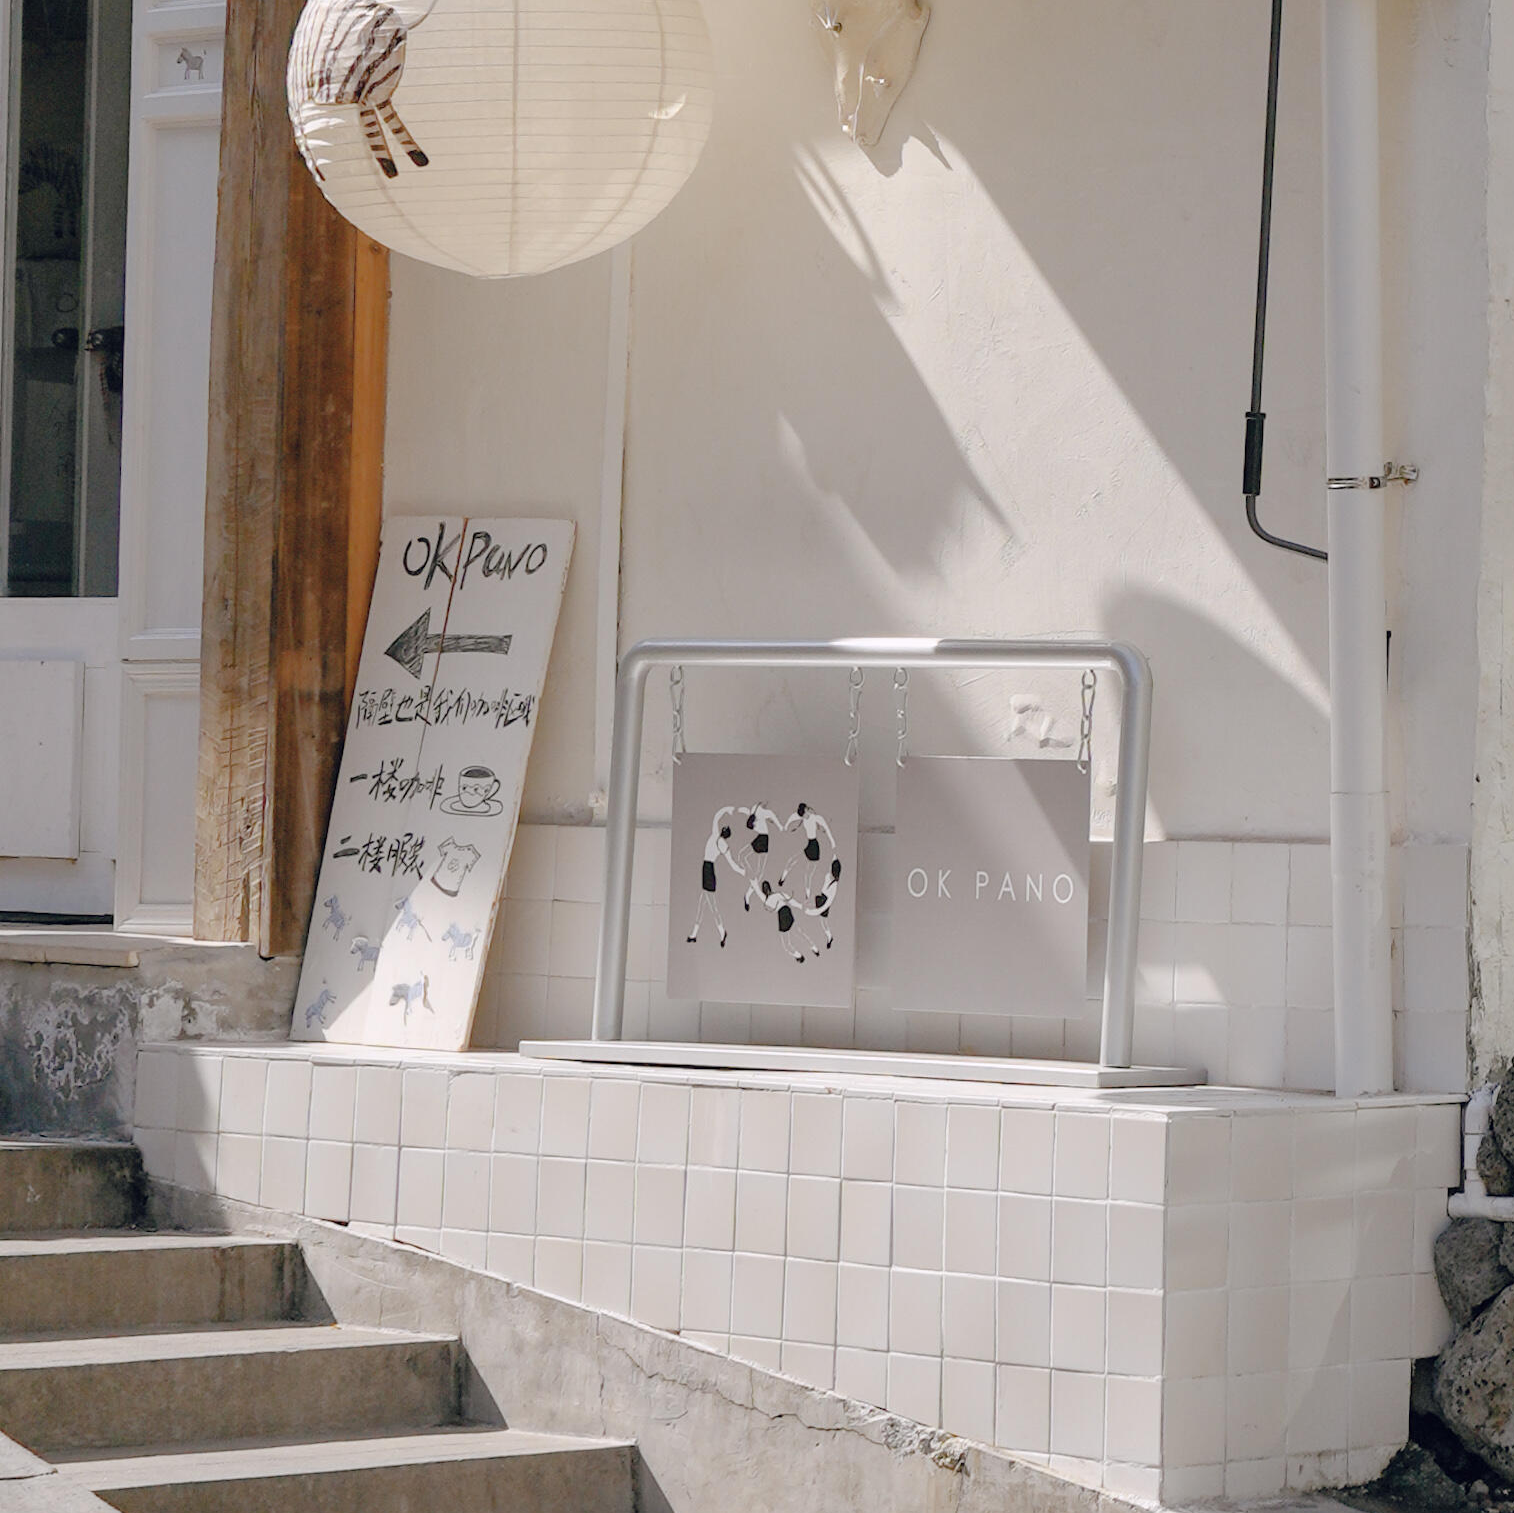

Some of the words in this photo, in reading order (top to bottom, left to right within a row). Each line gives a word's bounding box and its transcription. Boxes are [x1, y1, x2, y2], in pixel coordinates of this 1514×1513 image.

[402, 522, 462, 590] OK
[349, 757, 446, 811] 一楼咖啡
[333, 833, 425, 880] 二楼服装
[907, 868, 952, 900] OK
[975, 871, 1075, 904] PANO
